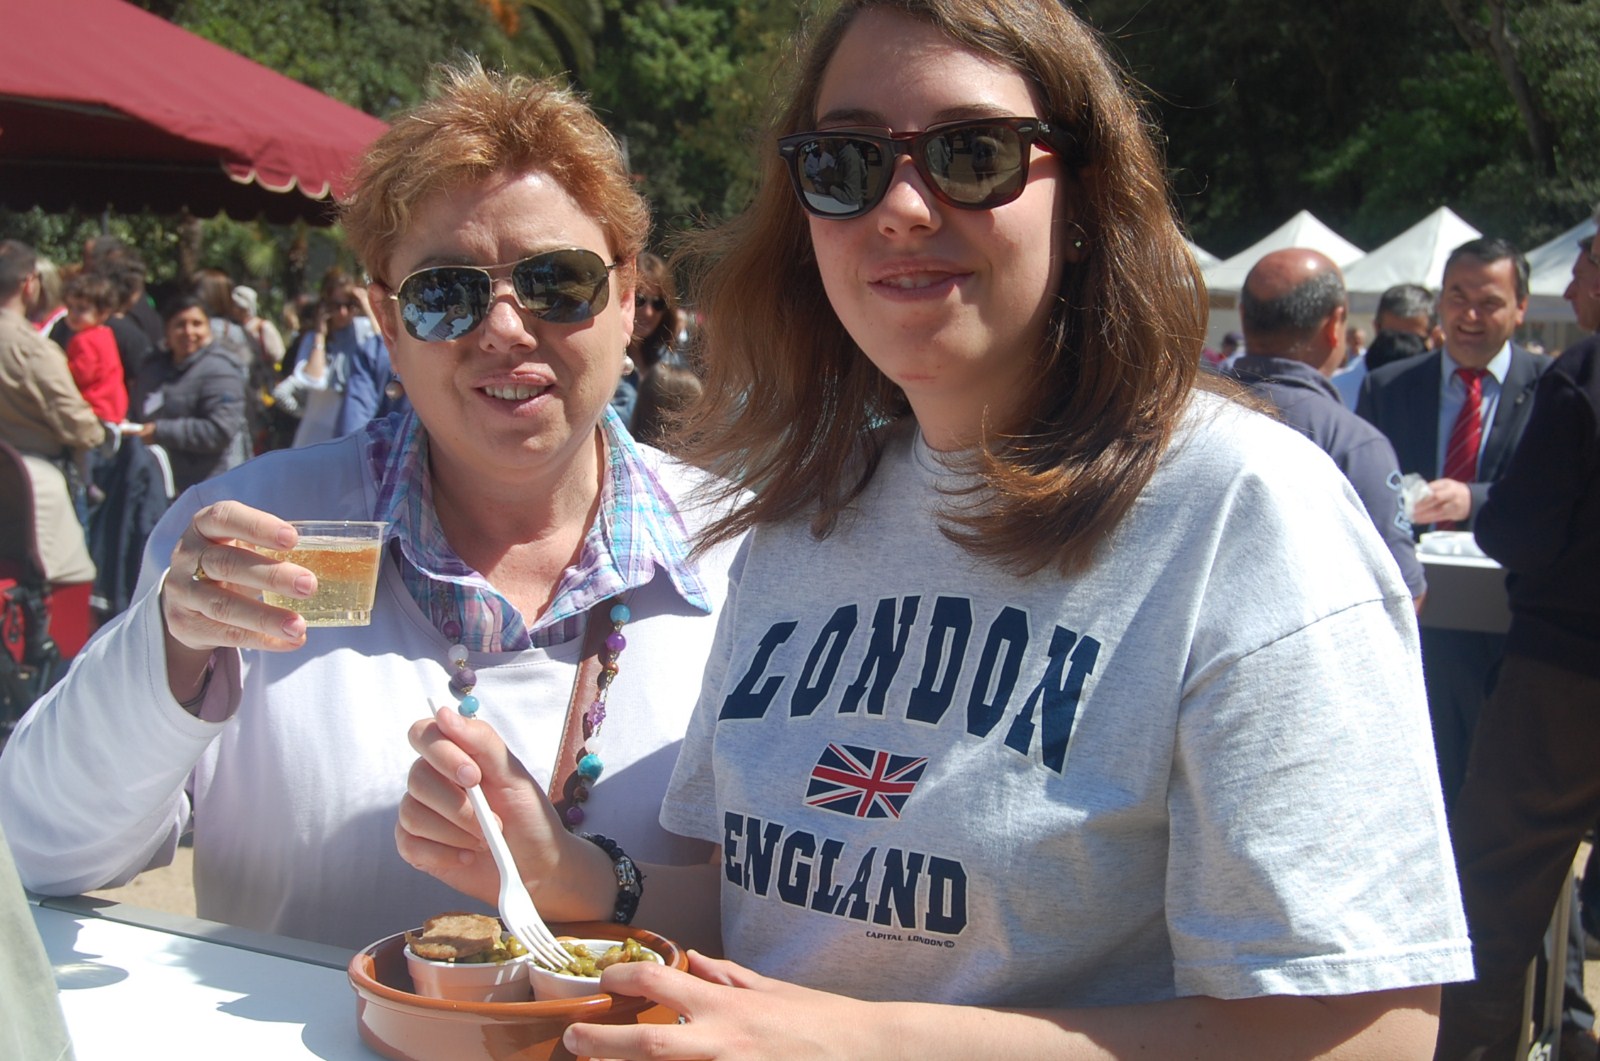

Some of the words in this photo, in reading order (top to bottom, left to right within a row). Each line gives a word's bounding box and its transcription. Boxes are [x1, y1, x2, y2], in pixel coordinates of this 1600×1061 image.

[718, 595, 1101, 775] LONDON
[724, 811, 968, 935] ENGLAND
[866, 931, 903, 941] CAPITAL
